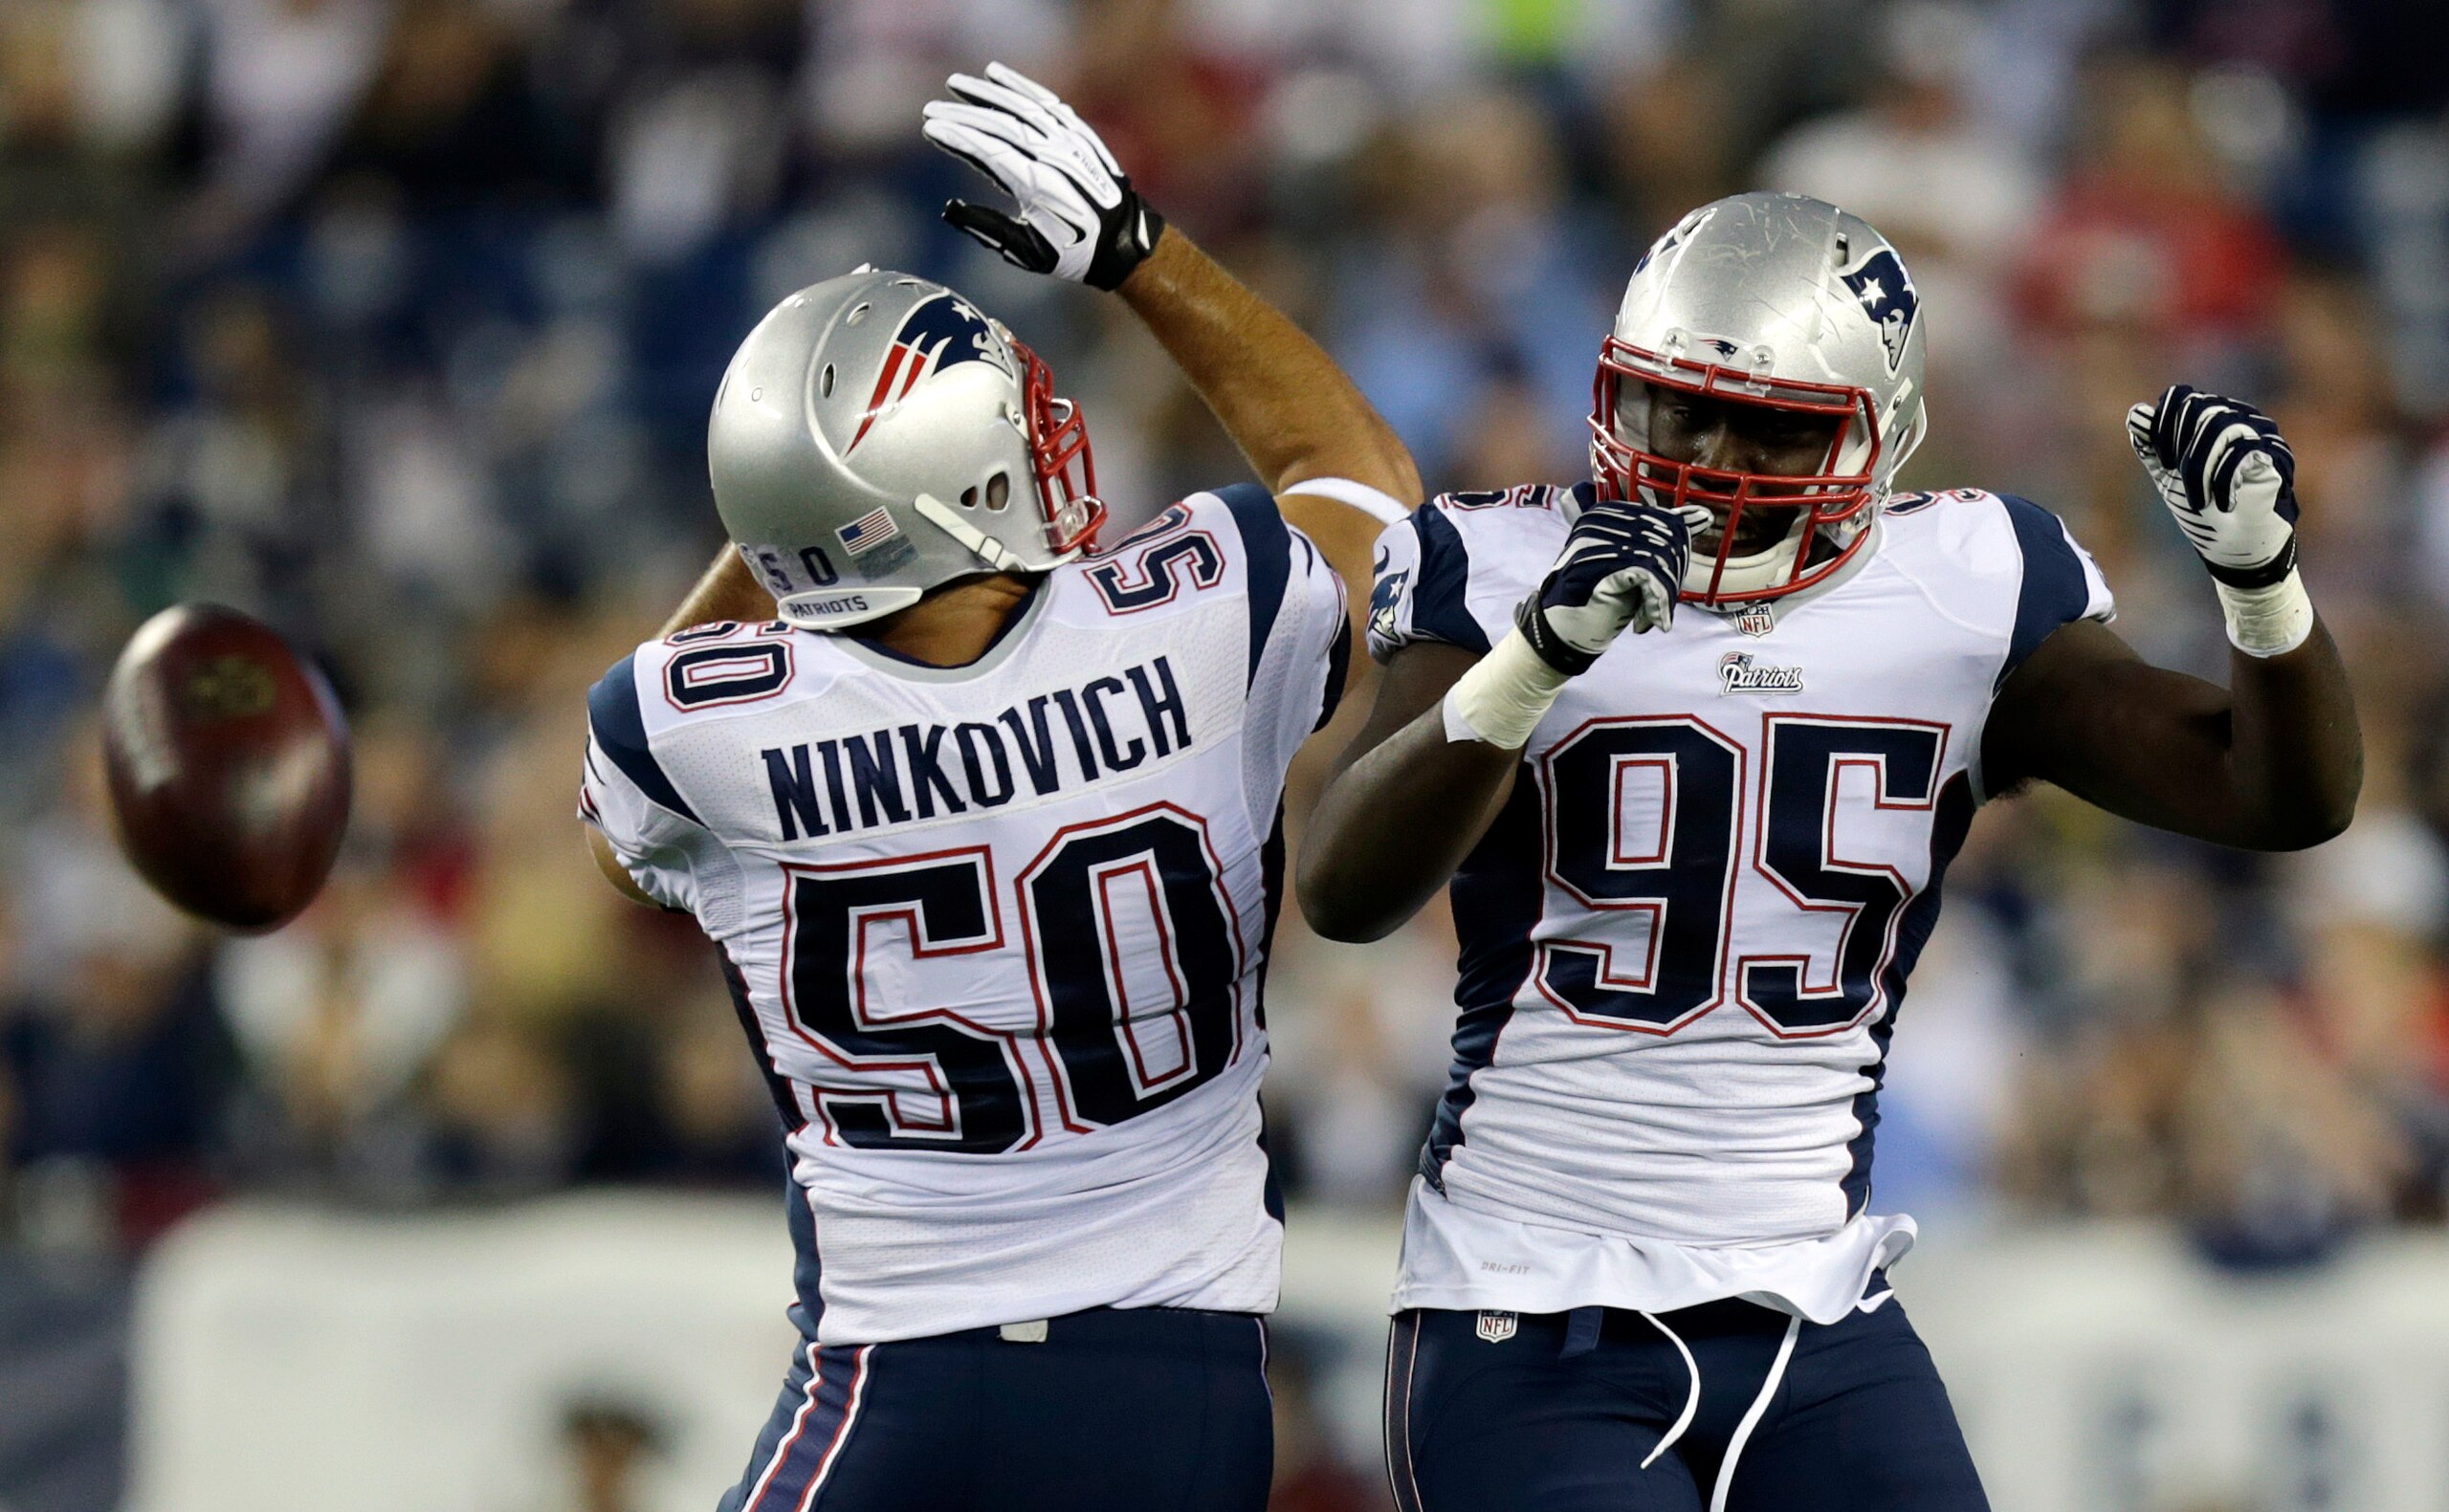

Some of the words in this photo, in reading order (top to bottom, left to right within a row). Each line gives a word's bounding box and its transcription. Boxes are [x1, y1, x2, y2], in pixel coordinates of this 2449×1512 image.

[788, 595, 869, 618] PATRIOTS
[1741, 615, 1770, 633] NFL
[1721, 663, 1804, 694] Patriots
[762, 655, 1192, 842] NINKOVICH
[1533, 712, 1953, 1040] 95
[779, 800, 1246, 1153] 50
[1480, 1260, 1530, 1275] DRI-FIT
[1483, 1317, 1511, 1335] NFL
